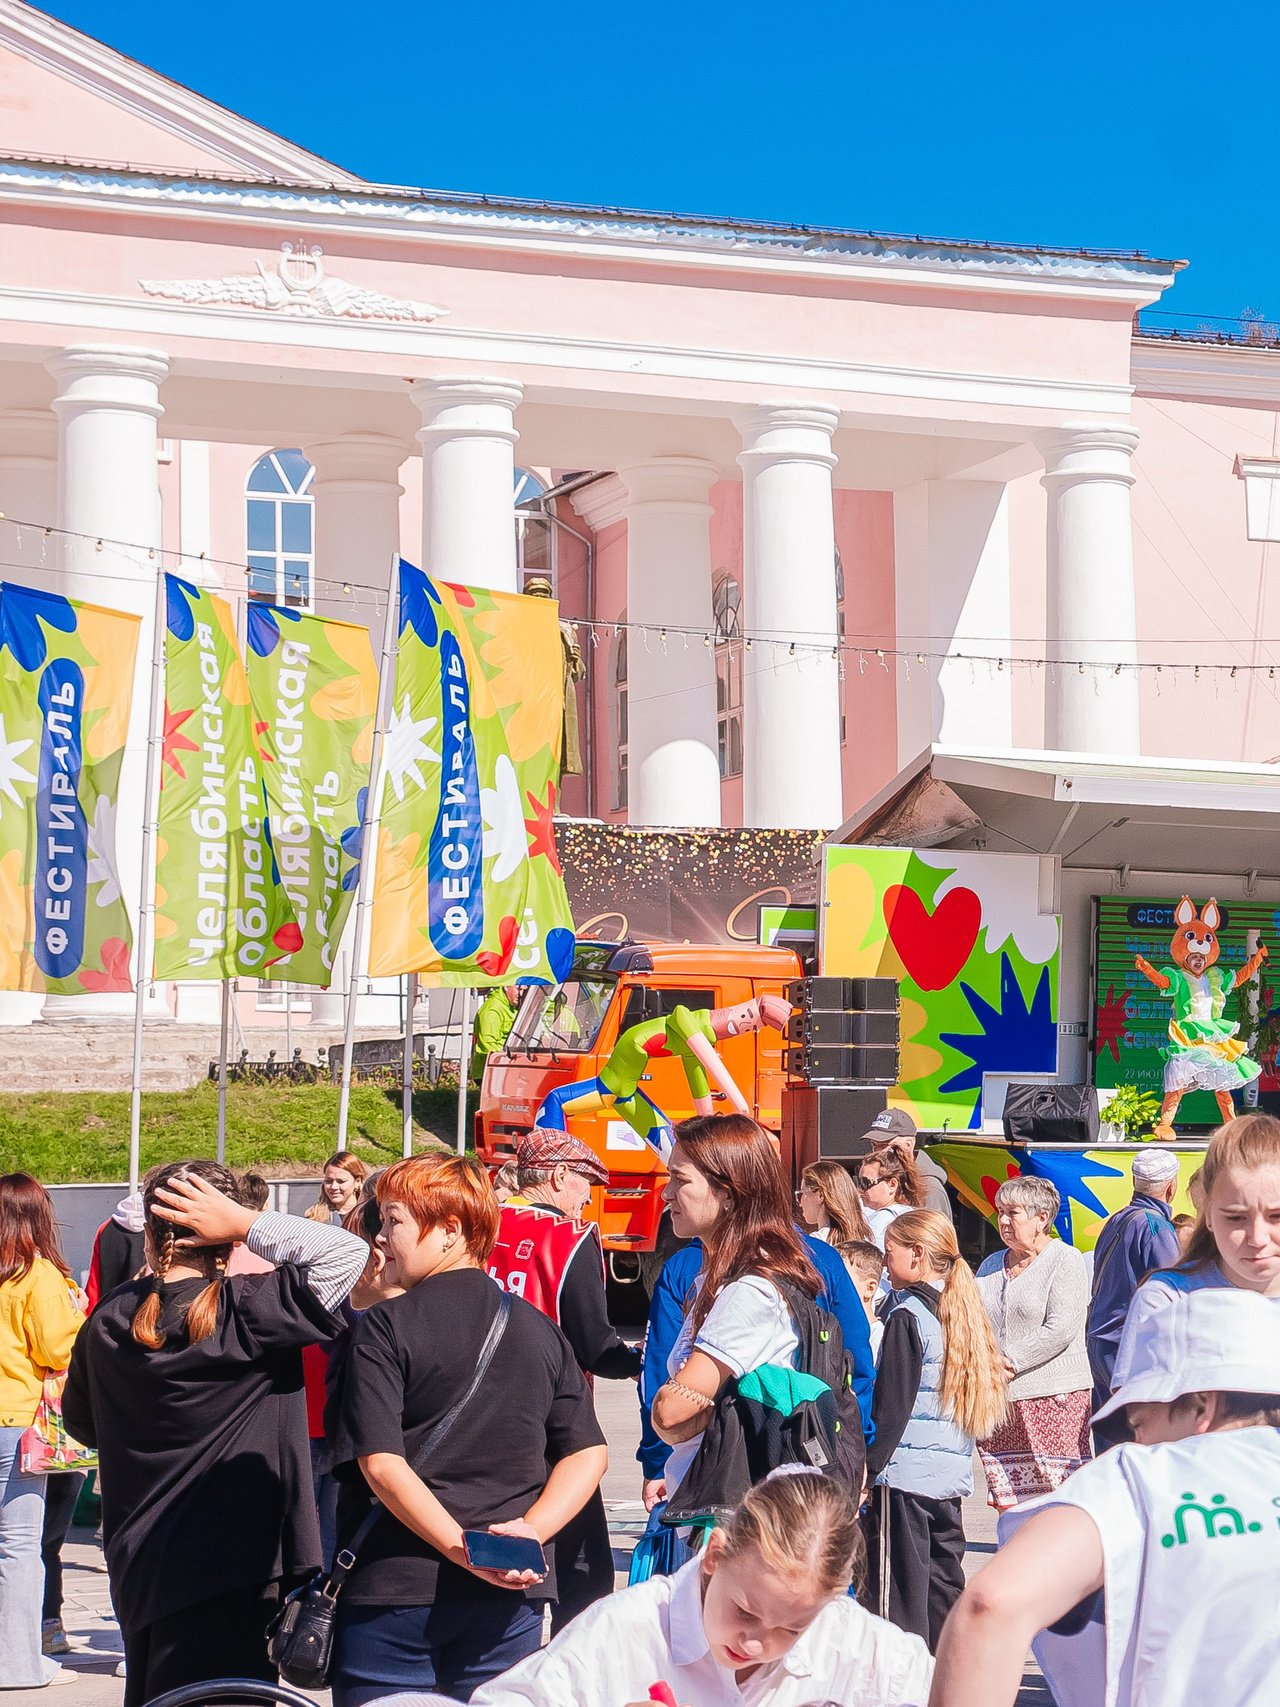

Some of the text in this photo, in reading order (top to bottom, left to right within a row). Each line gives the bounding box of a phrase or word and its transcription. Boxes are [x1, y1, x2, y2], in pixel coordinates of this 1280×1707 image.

[46, 681, 76, 956] ФЕСТИВАЛЬ
[188, 621, 229, 967] Челябинская
[235, 756, 269, 967] область
[442, 654, 470, 935] ФЕСТИВАЛЬ
[1124, 1031, 1171, 1049] семь
[1124, 1068, 1164, 1079] 22 ИЮЛ
[1125, 995, 1176, 1019] боль
